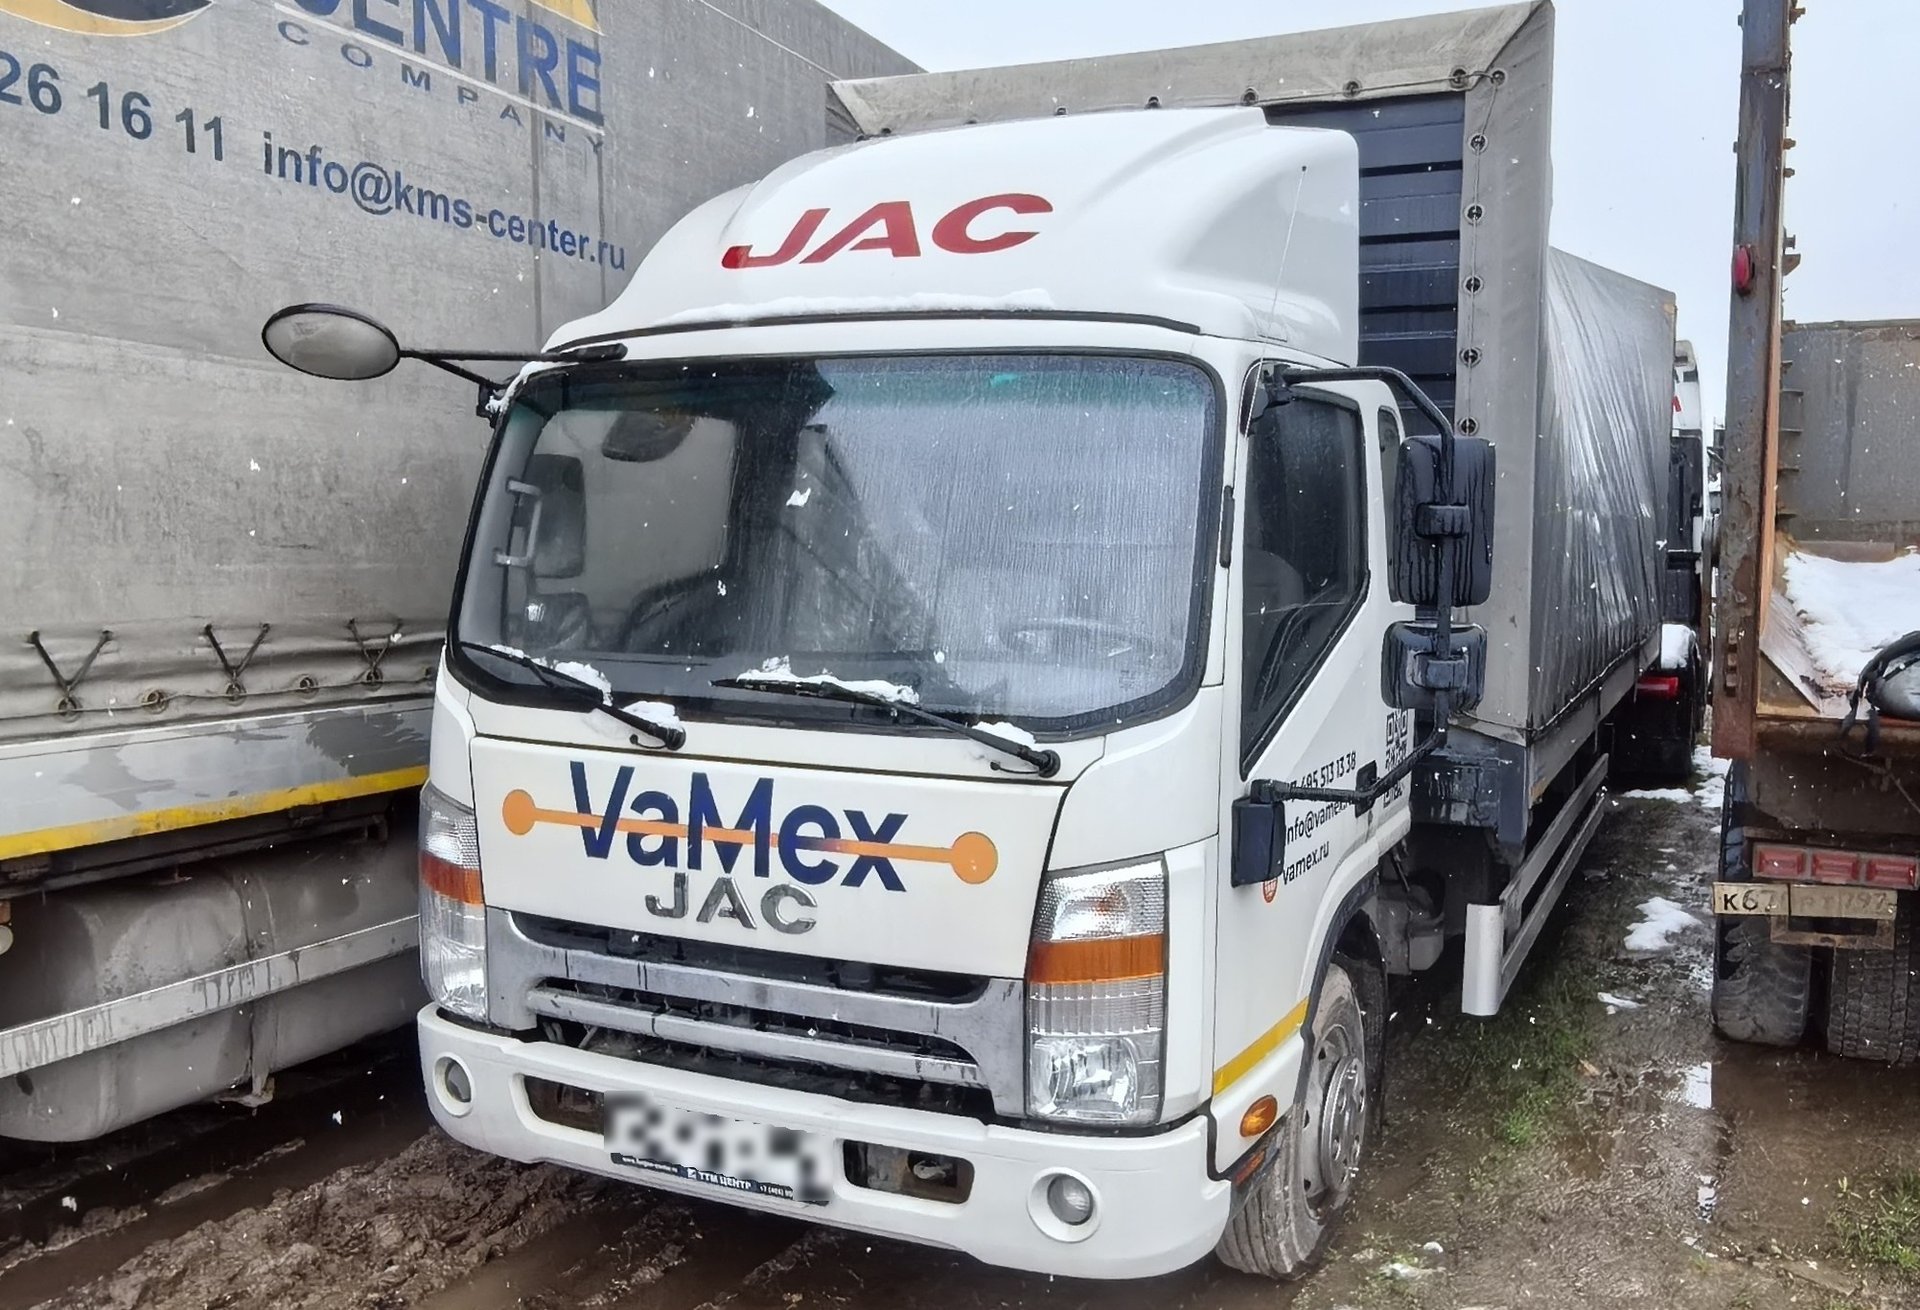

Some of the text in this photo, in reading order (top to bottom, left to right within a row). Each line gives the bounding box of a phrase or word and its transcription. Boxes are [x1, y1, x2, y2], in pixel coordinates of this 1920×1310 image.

[277, 20, 604, 155] COMPANY
[294, 0, 605, 127] ENTRE
[87, 81, 152, 140] 16
[175, 107, 223, 162] 11
[263, 131, 625, 271] info@kms-center.ru
[722, 193, 1053, 269] JAC
[1346, 751, 1356, 773] 38
[569, 760, 908, 892] VaMex
[1282, 841, 1330, 885] vamex.ru
[644, 872, 818, 935] JAC
[720, 1174, 752, 1190] ЦЕНТР
